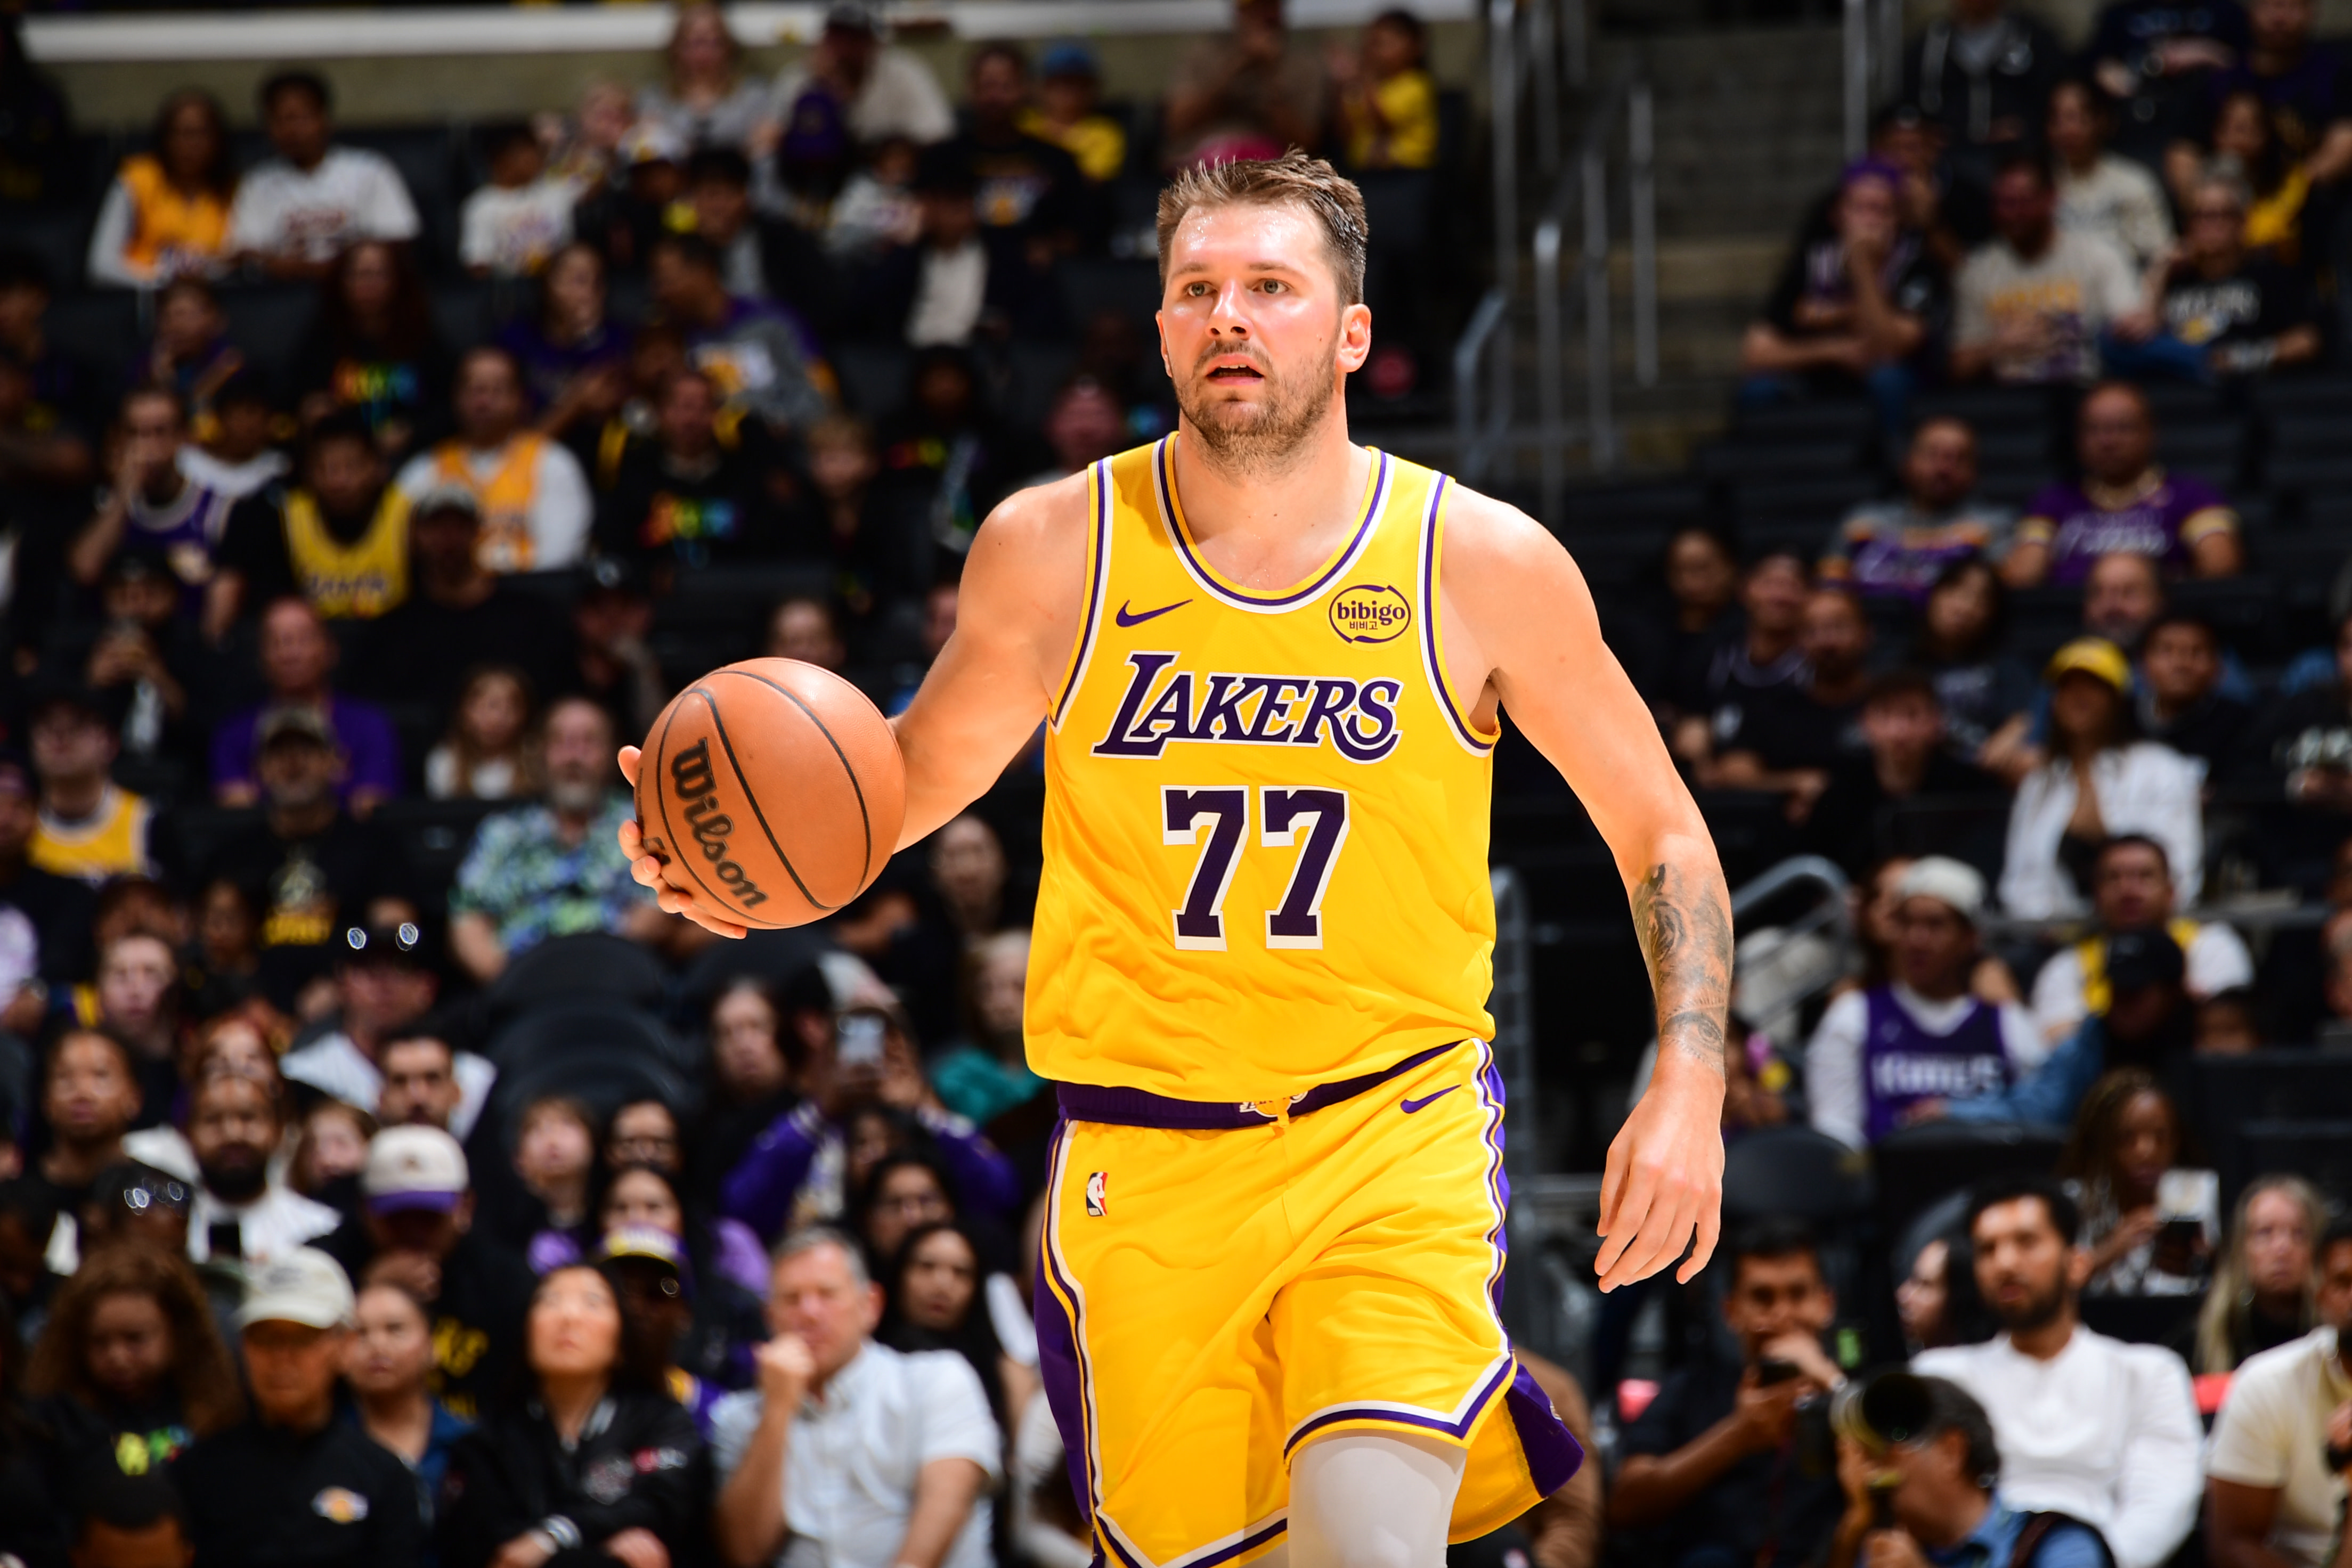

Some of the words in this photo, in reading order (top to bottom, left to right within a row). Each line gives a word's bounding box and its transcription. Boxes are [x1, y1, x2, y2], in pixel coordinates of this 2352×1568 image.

[1337, 600, 1405, 626] bibigo
[1349, 621, 1378, 631] 비비고
[1089, 651, 1404, 765] LAKERS
[671, 737, 768, 909] Wilson
[1160, 785, 1350, 952] 77
